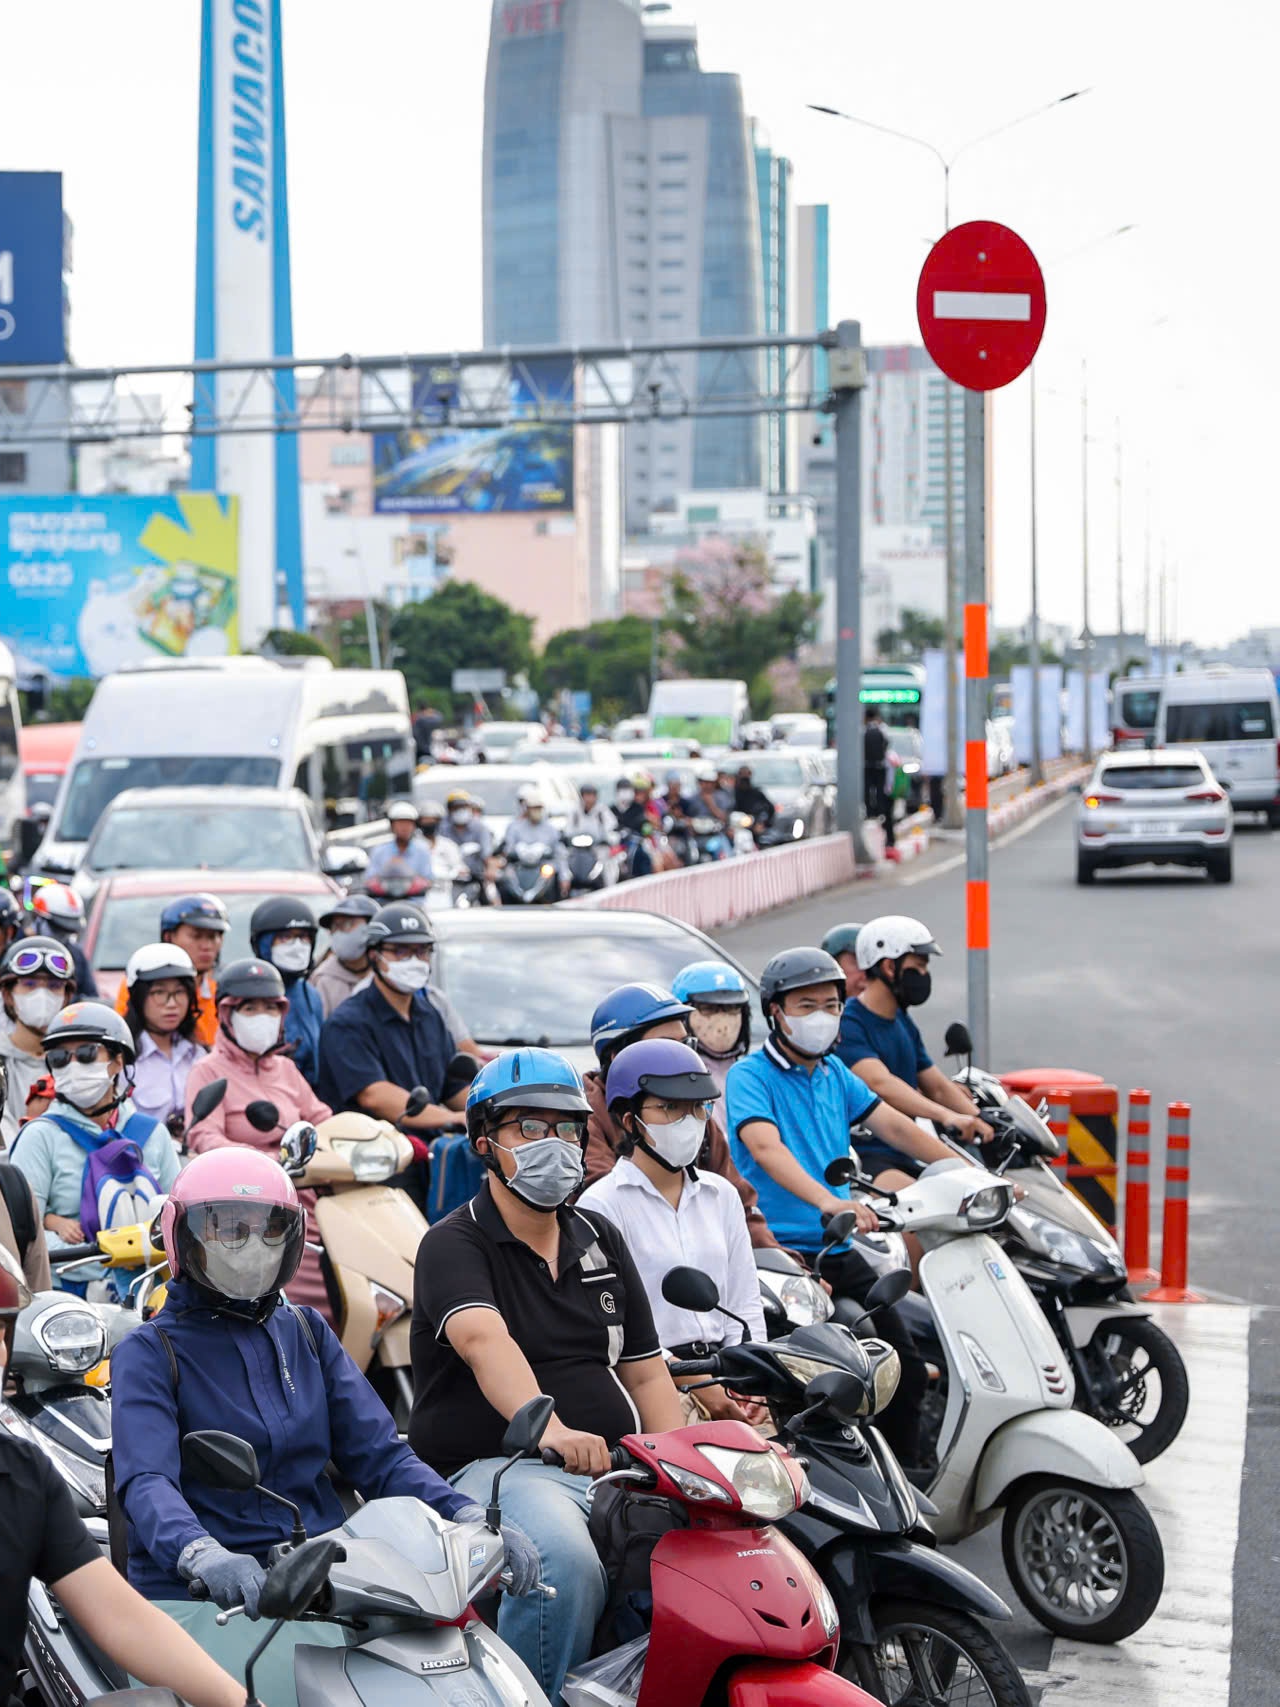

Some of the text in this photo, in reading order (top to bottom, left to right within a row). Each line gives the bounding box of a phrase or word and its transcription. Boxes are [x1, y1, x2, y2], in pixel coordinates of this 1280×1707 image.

[600, 1291, 616, 1313] G
[736, 1548, 777, 1558] HONDA
[422, 1657, 466, 1670] HONDA
